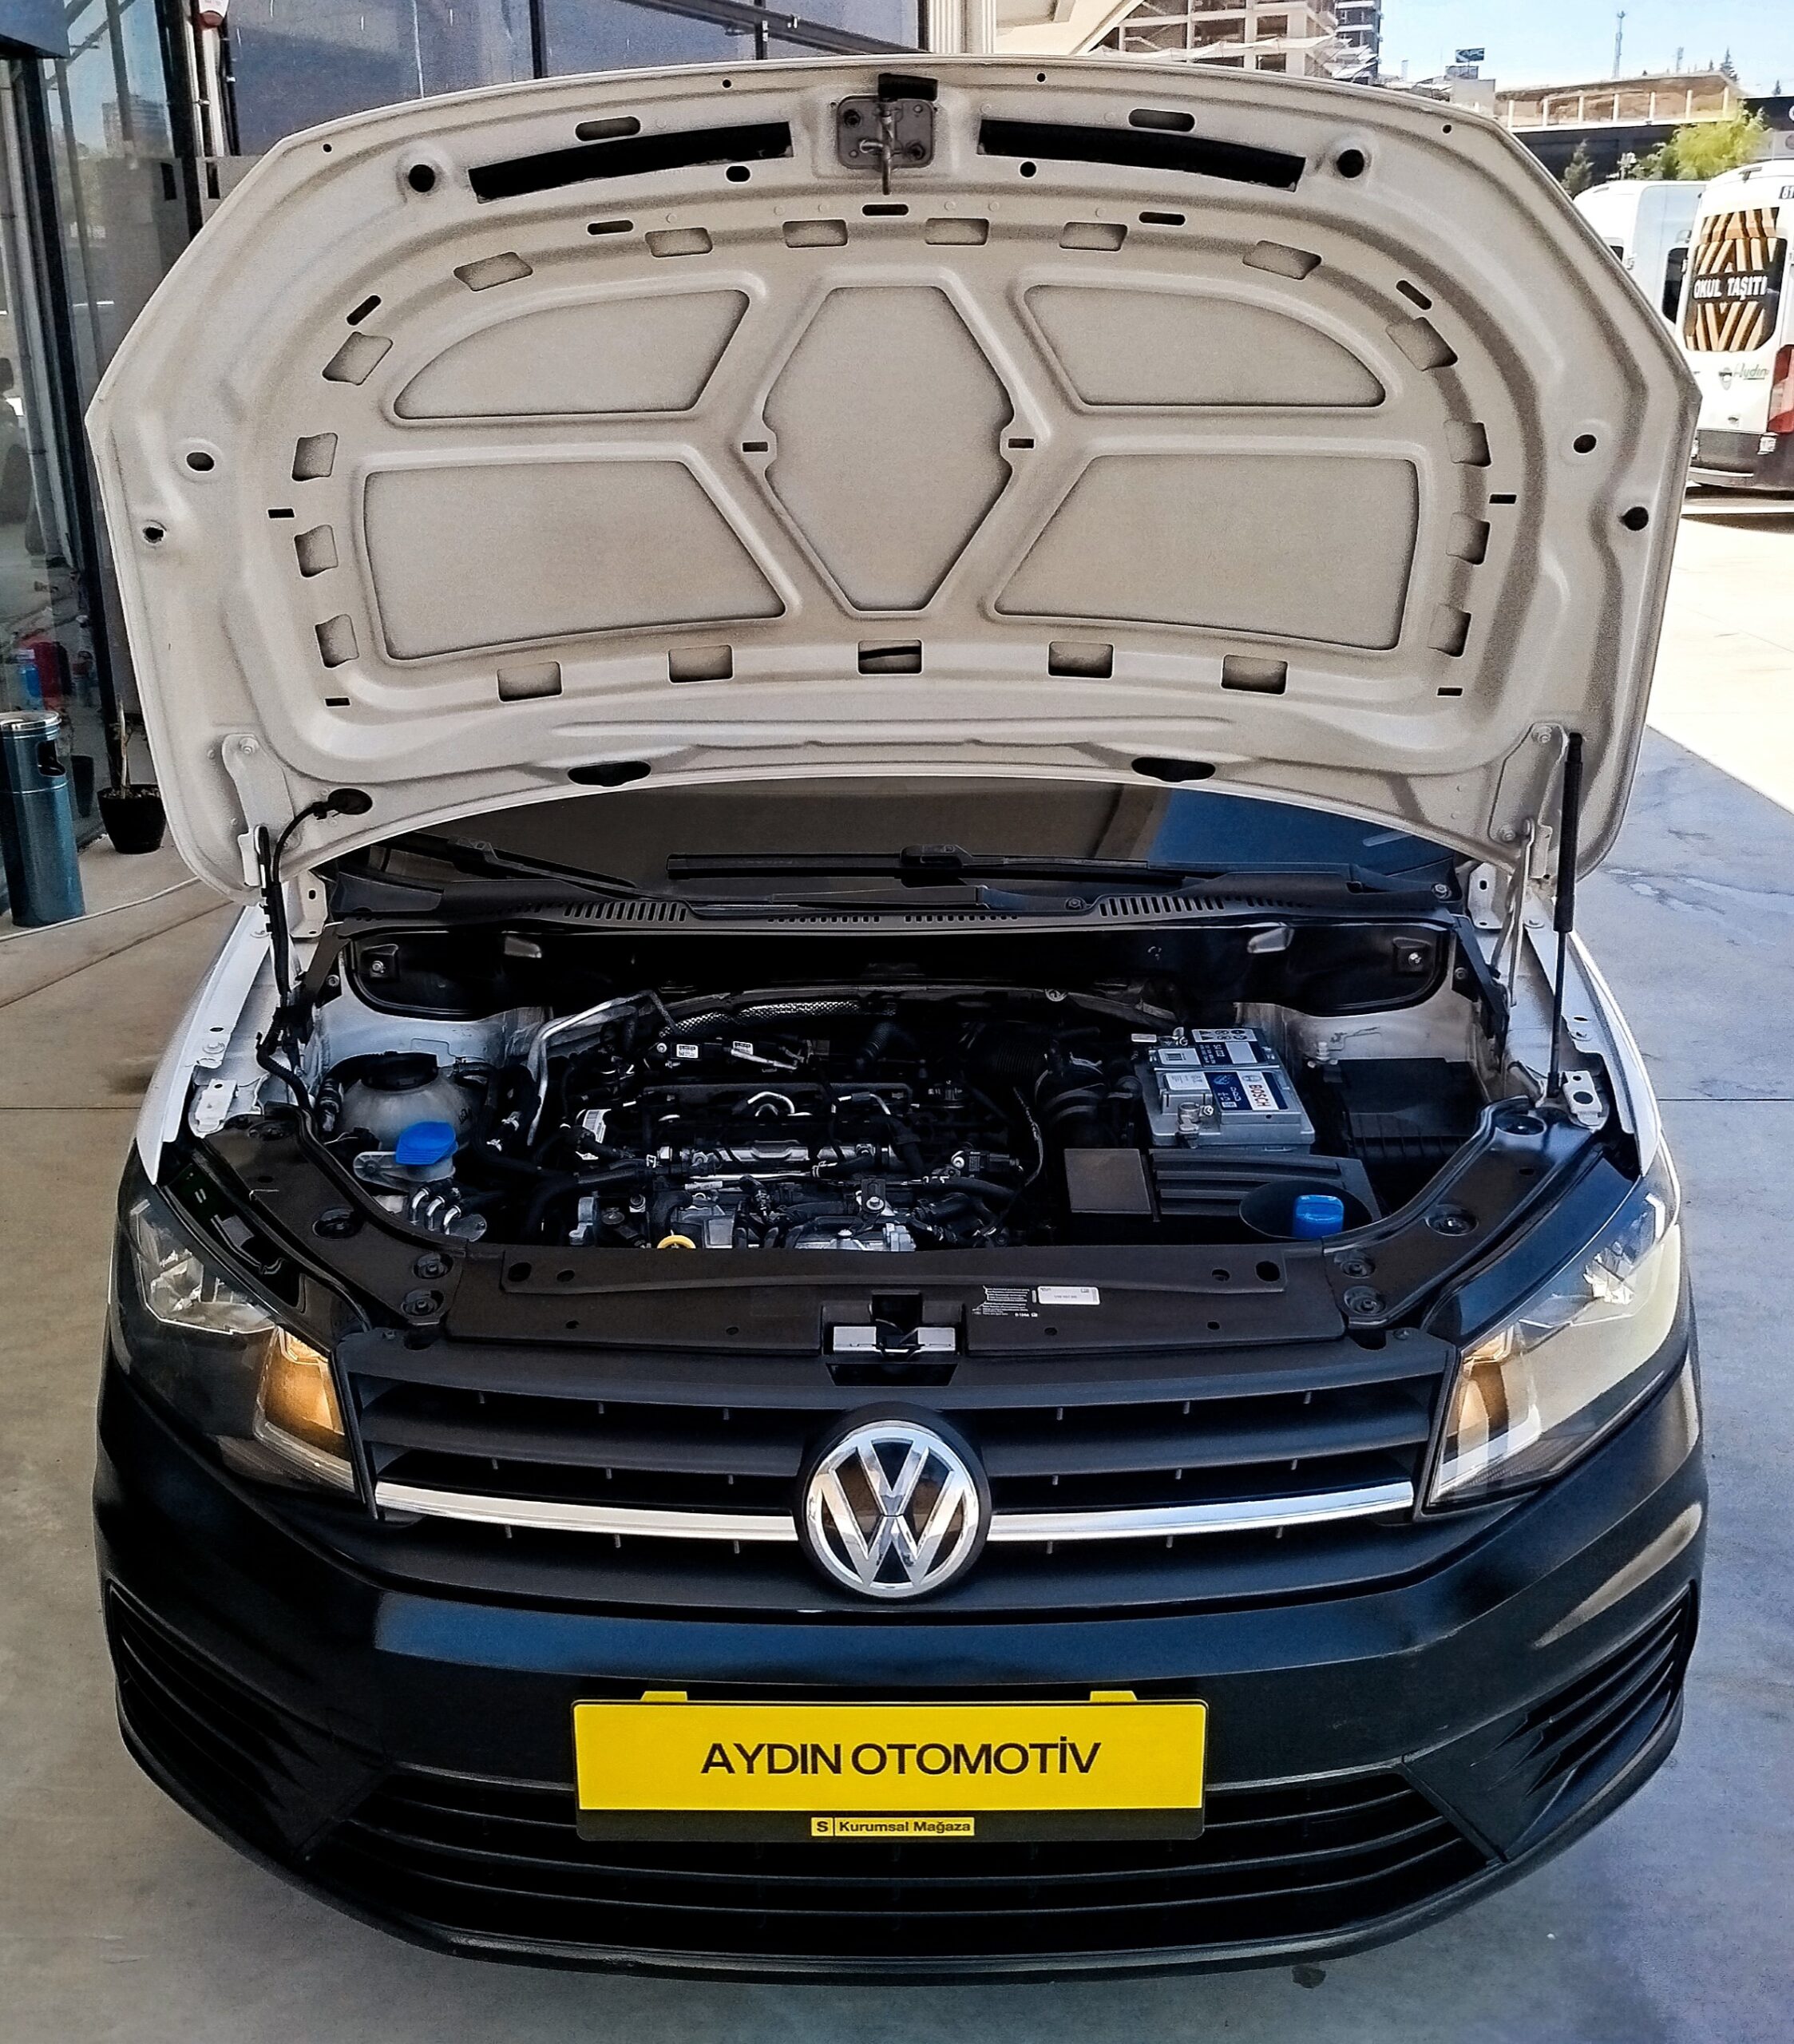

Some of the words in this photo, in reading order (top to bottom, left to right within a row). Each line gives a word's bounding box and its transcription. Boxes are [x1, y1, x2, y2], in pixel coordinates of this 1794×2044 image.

[1693, 279, 1722, 299] OKUL
[1727, 275, 1768, 301] TAŞITI
[1248, 1084, 1271, 1107] BOSCH
[700, 1743, 842, 1774] AYDIN
[851, 1736, 1102, 1775] OTOMOTİV
[817, 1821, 828, 1832] S
[839, 1821, 909, 1832] Kurumsal
[913, 1821, 970, 1833] Mağaza
